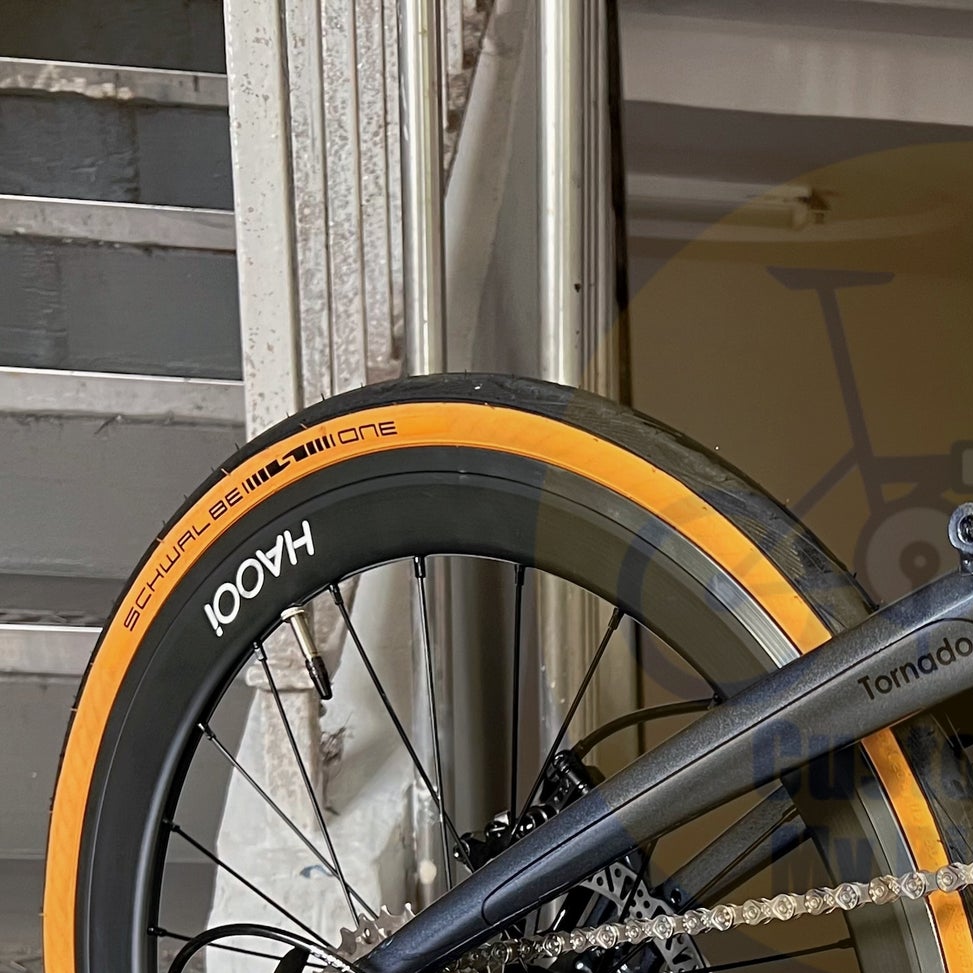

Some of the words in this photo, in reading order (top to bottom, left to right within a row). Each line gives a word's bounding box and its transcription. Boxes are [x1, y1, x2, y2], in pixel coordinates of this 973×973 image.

[123, 487, 244, 632] SCHWALBE
[337, 421, 398, 445] ONE
[857, 637, 973, 700] Tornado
